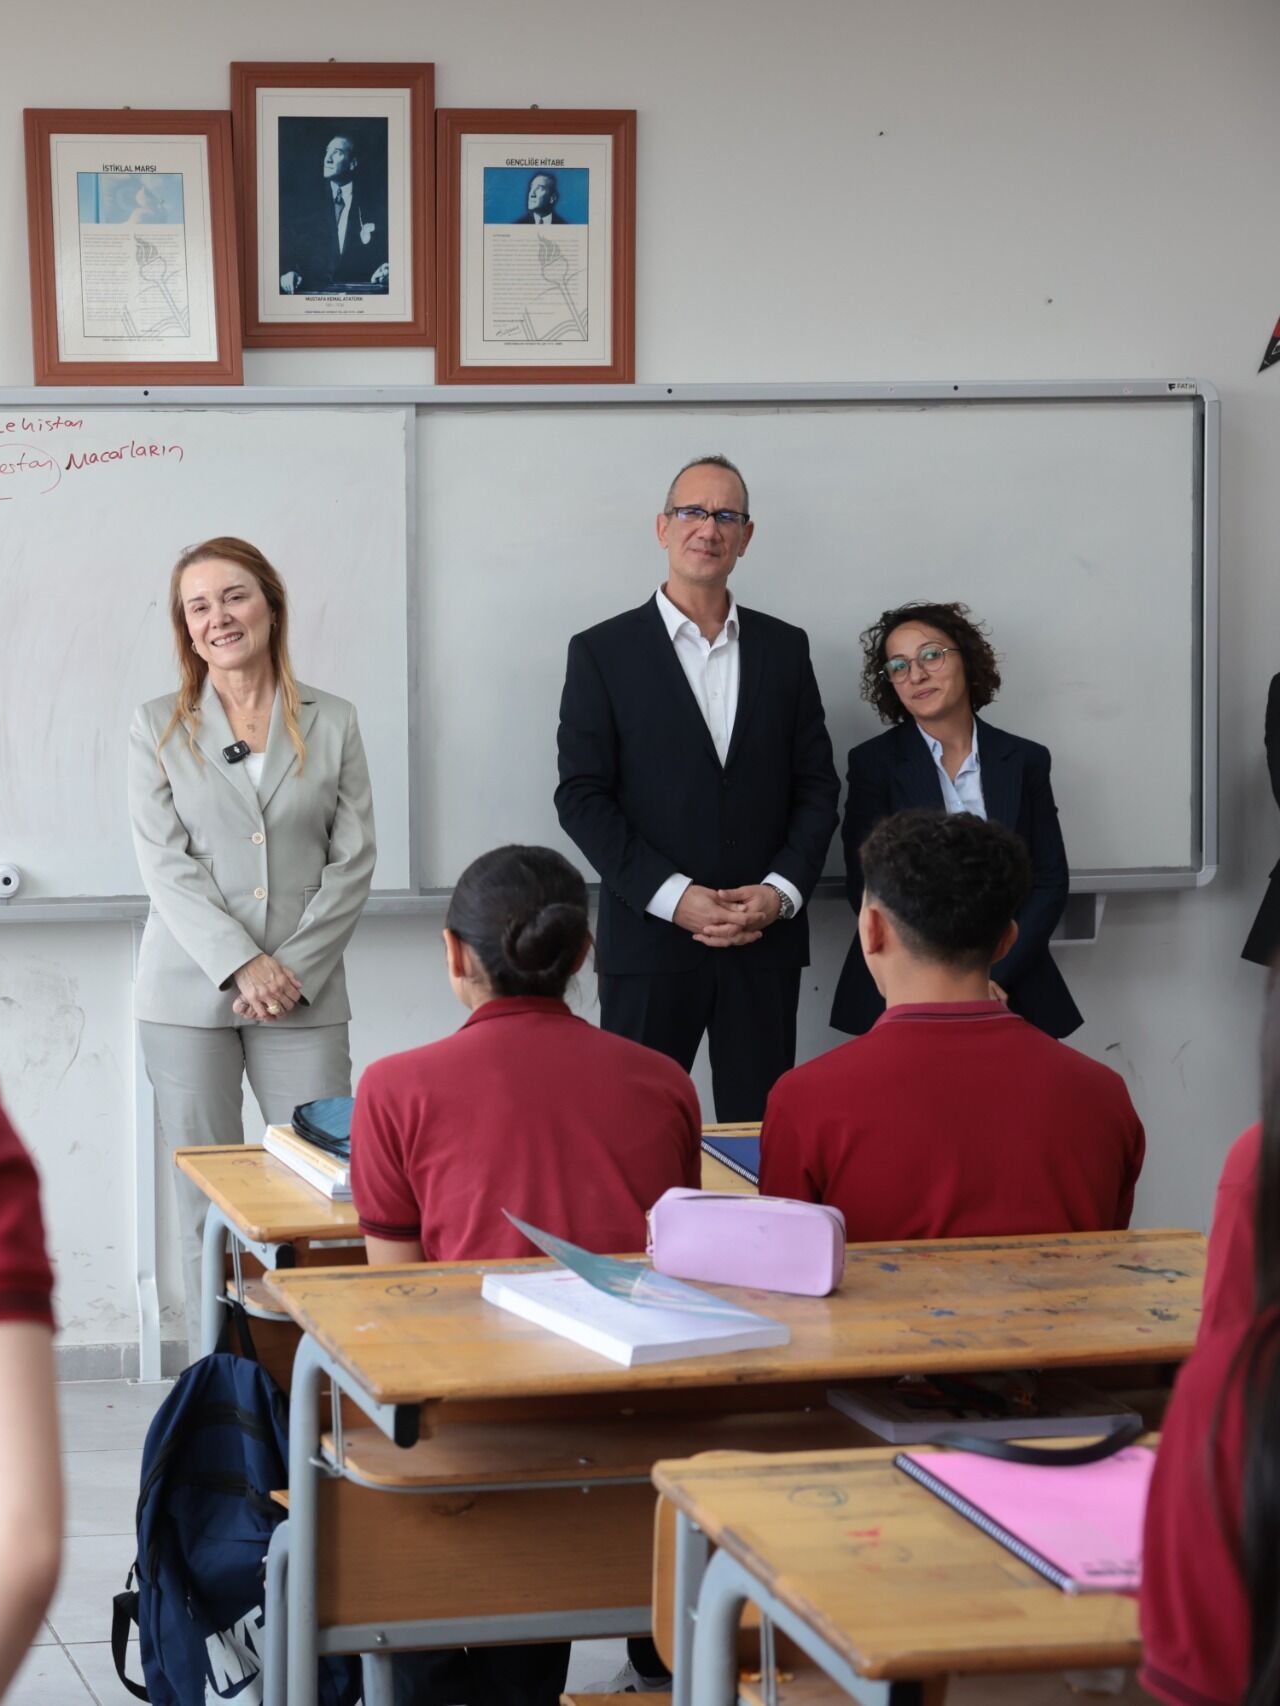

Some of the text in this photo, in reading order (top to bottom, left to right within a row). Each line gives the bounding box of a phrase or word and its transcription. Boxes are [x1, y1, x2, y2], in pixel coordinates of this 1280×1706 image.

[506, 157, 565, 167] GENÇLİĞE HİTABE
[102, 164, 157, 173] İSTİKLAL MARŞI
